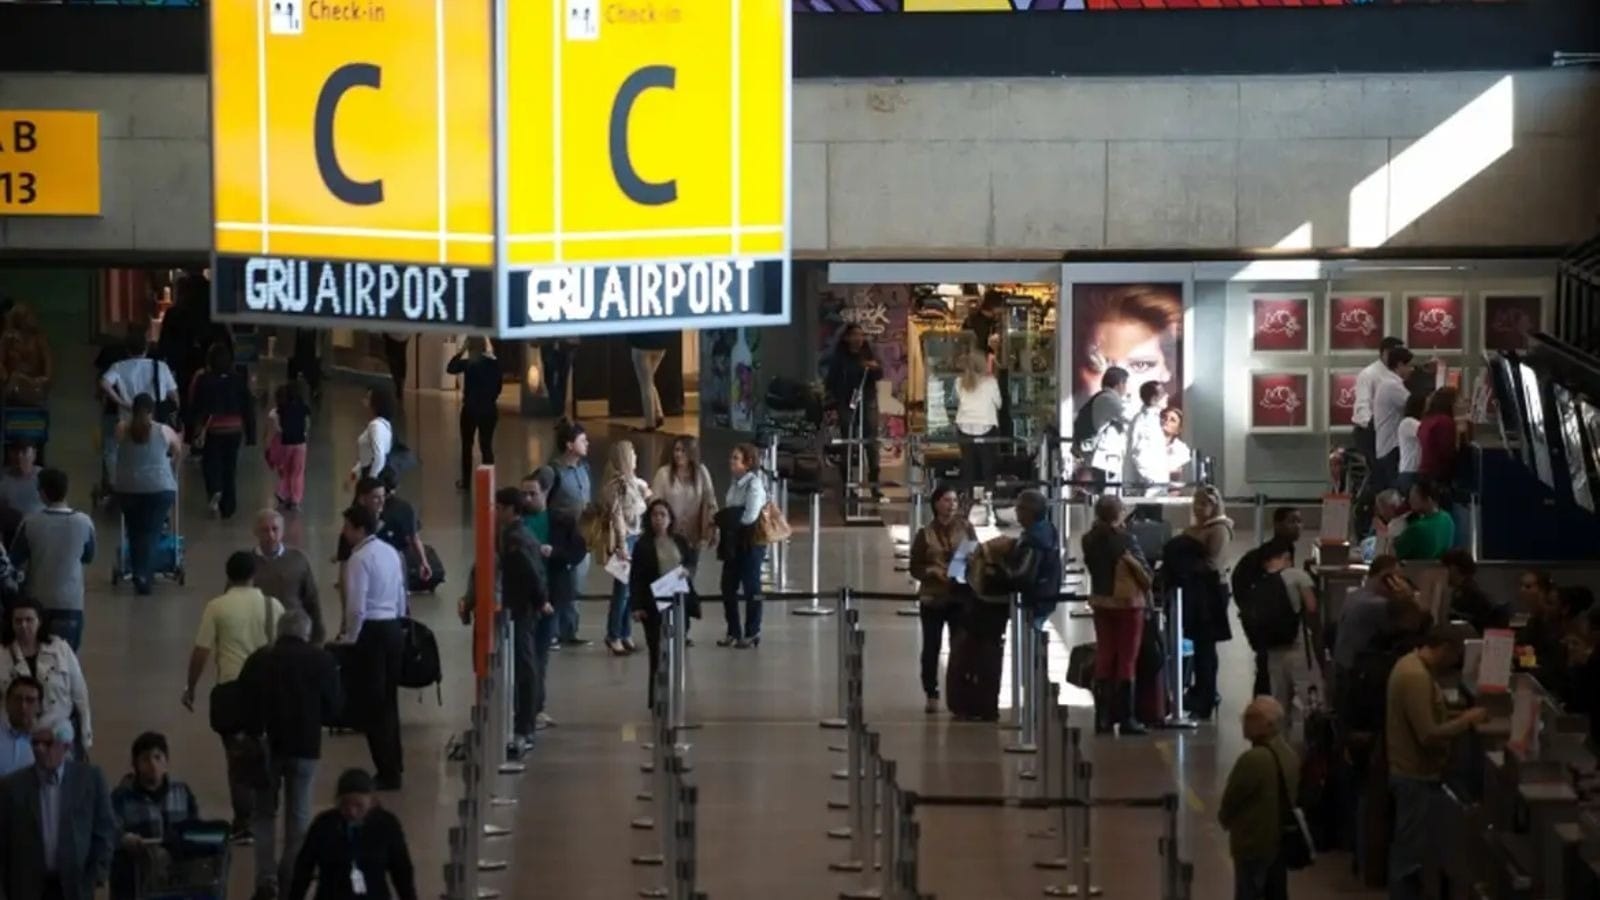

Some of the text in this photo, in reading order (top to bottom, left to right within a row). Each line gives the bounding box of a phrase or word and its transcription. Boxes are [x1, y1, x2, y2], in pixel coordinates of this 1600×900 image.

[309, 0, 385, 22] Check-in
[606, 3, 682, 25] Check-in
[14, 121, 37, 153] B
[313, 62, 384, 206] C
[609, 64, 678, 206] C
[245, 257, 470, 322] GRU AIRPORT
[527, 259, 755, 322] GRU AIRPORT
